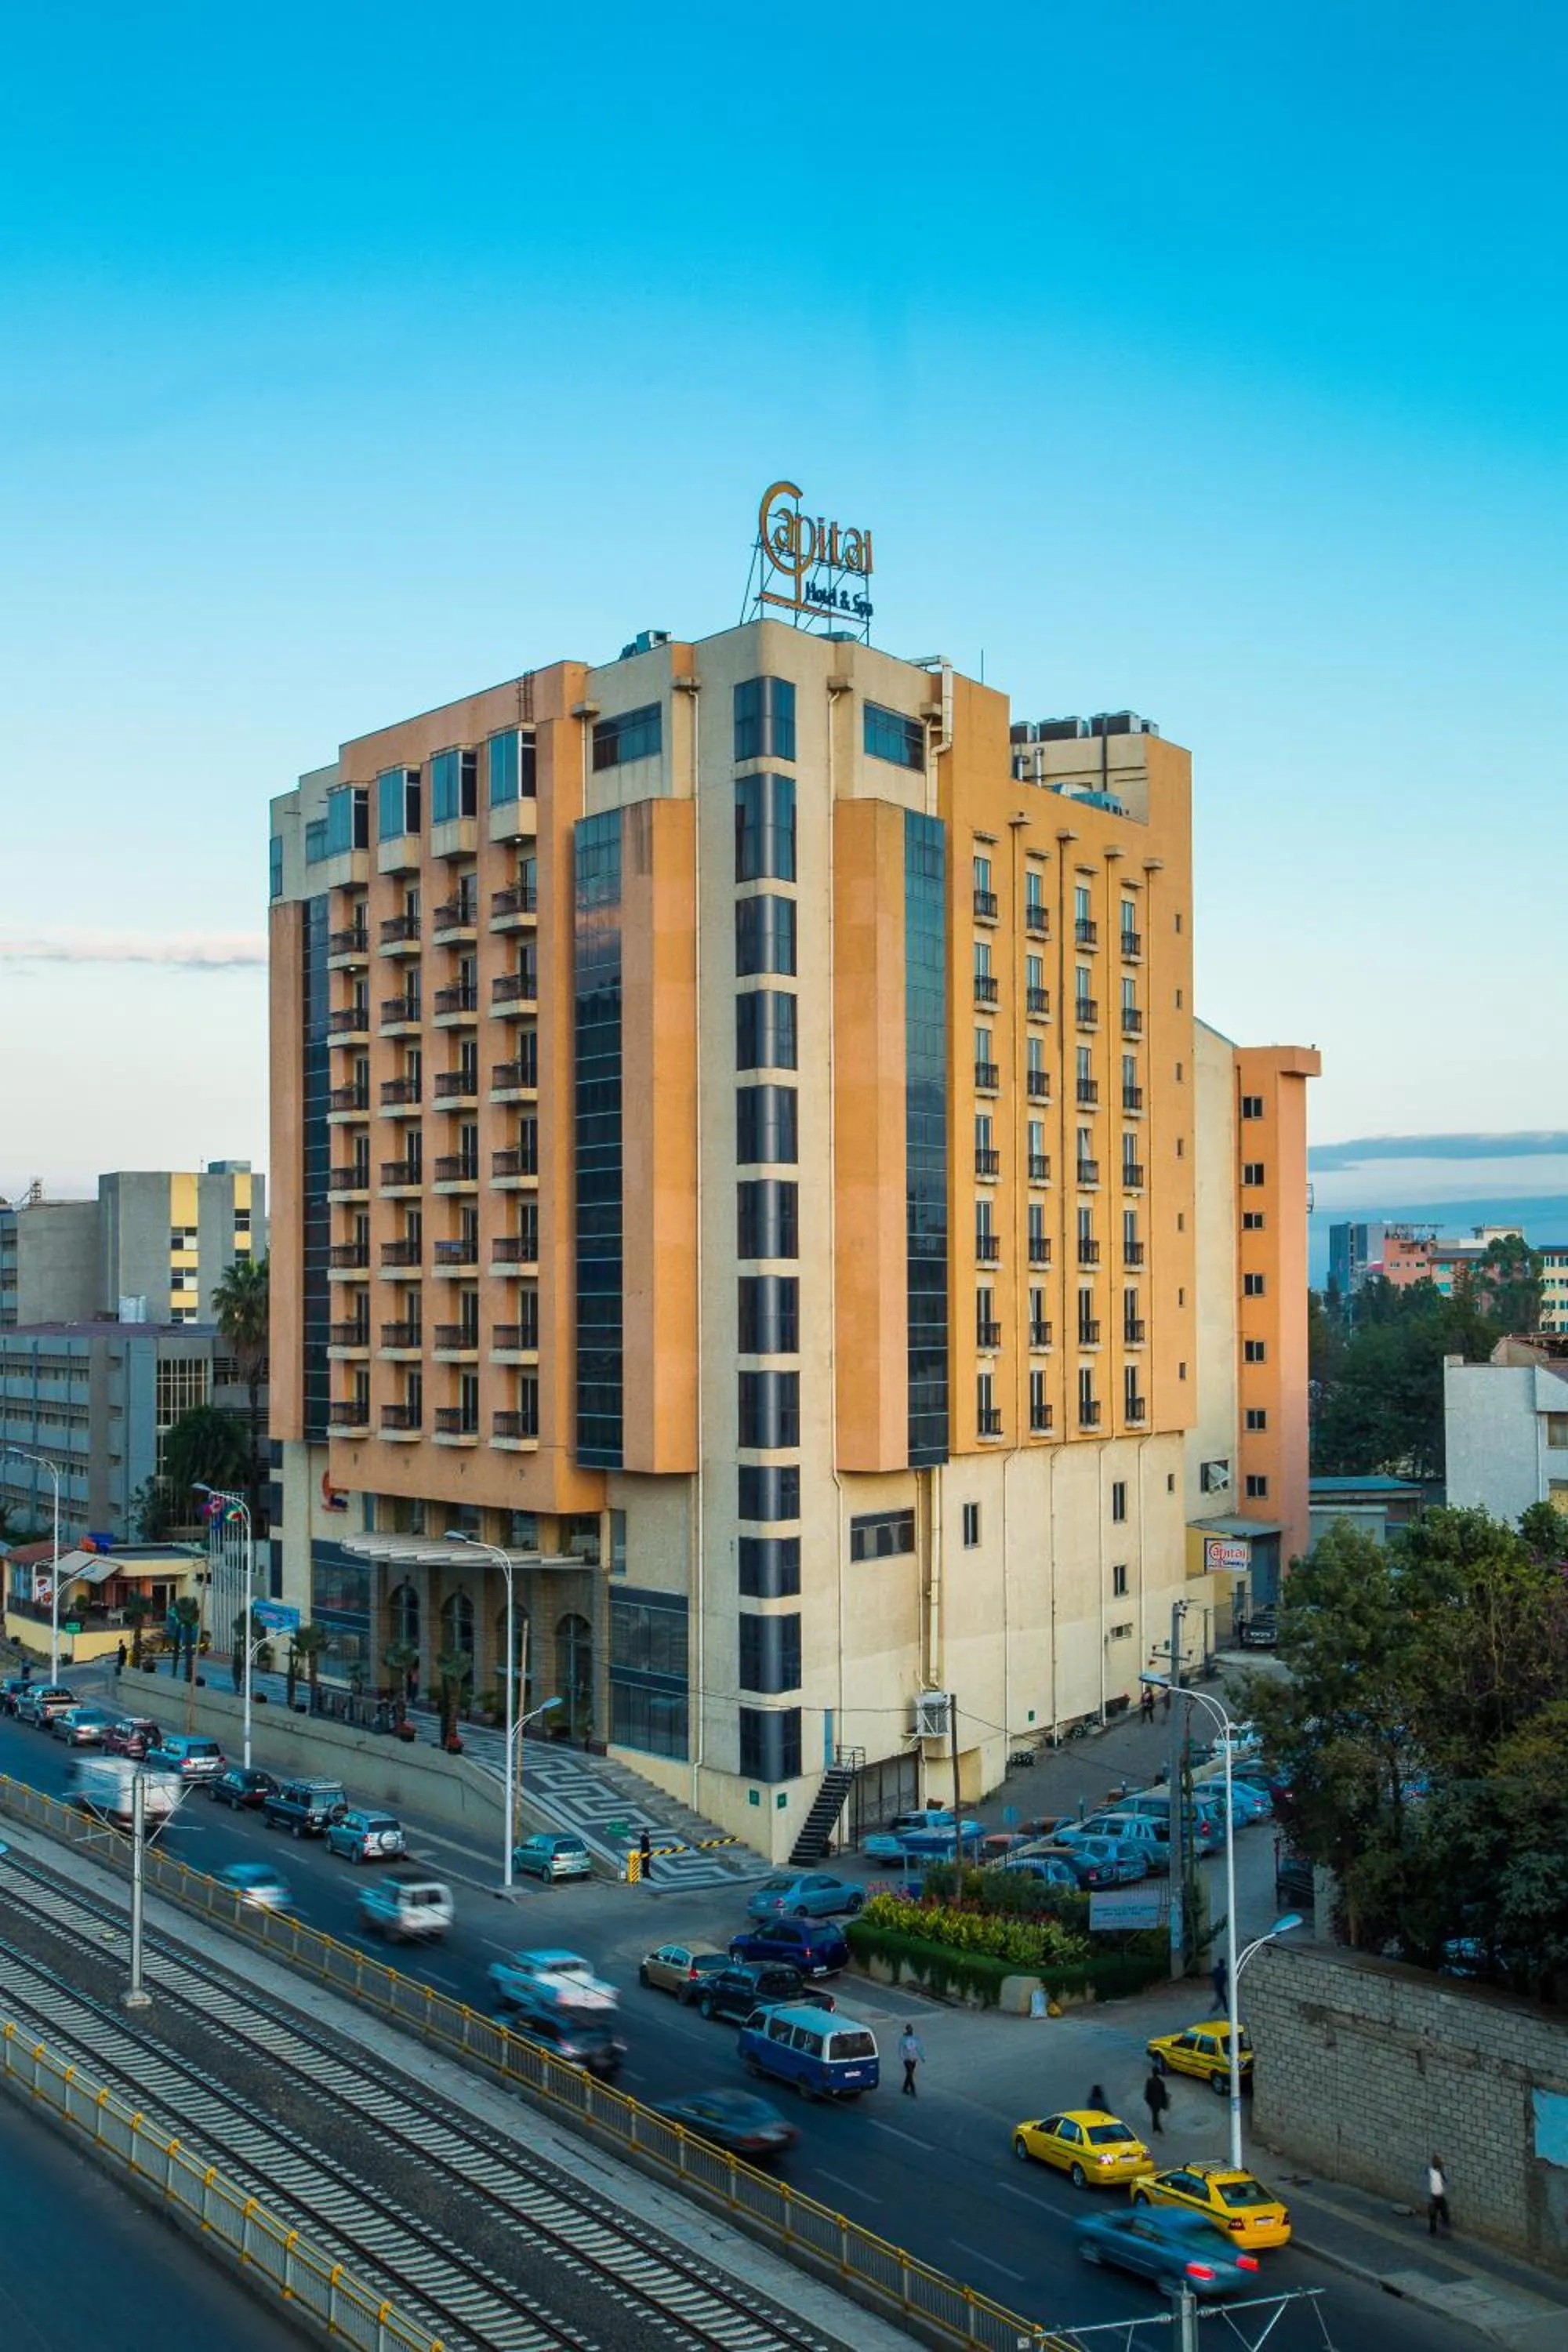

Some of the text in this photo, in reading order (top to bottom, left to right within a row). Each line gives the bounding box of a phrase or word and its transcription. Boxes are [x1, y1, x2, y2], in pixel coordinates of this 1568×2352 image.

[759, 481, 873, 606] Capital
[805, 581, 873, 619] Hotel & Spa
